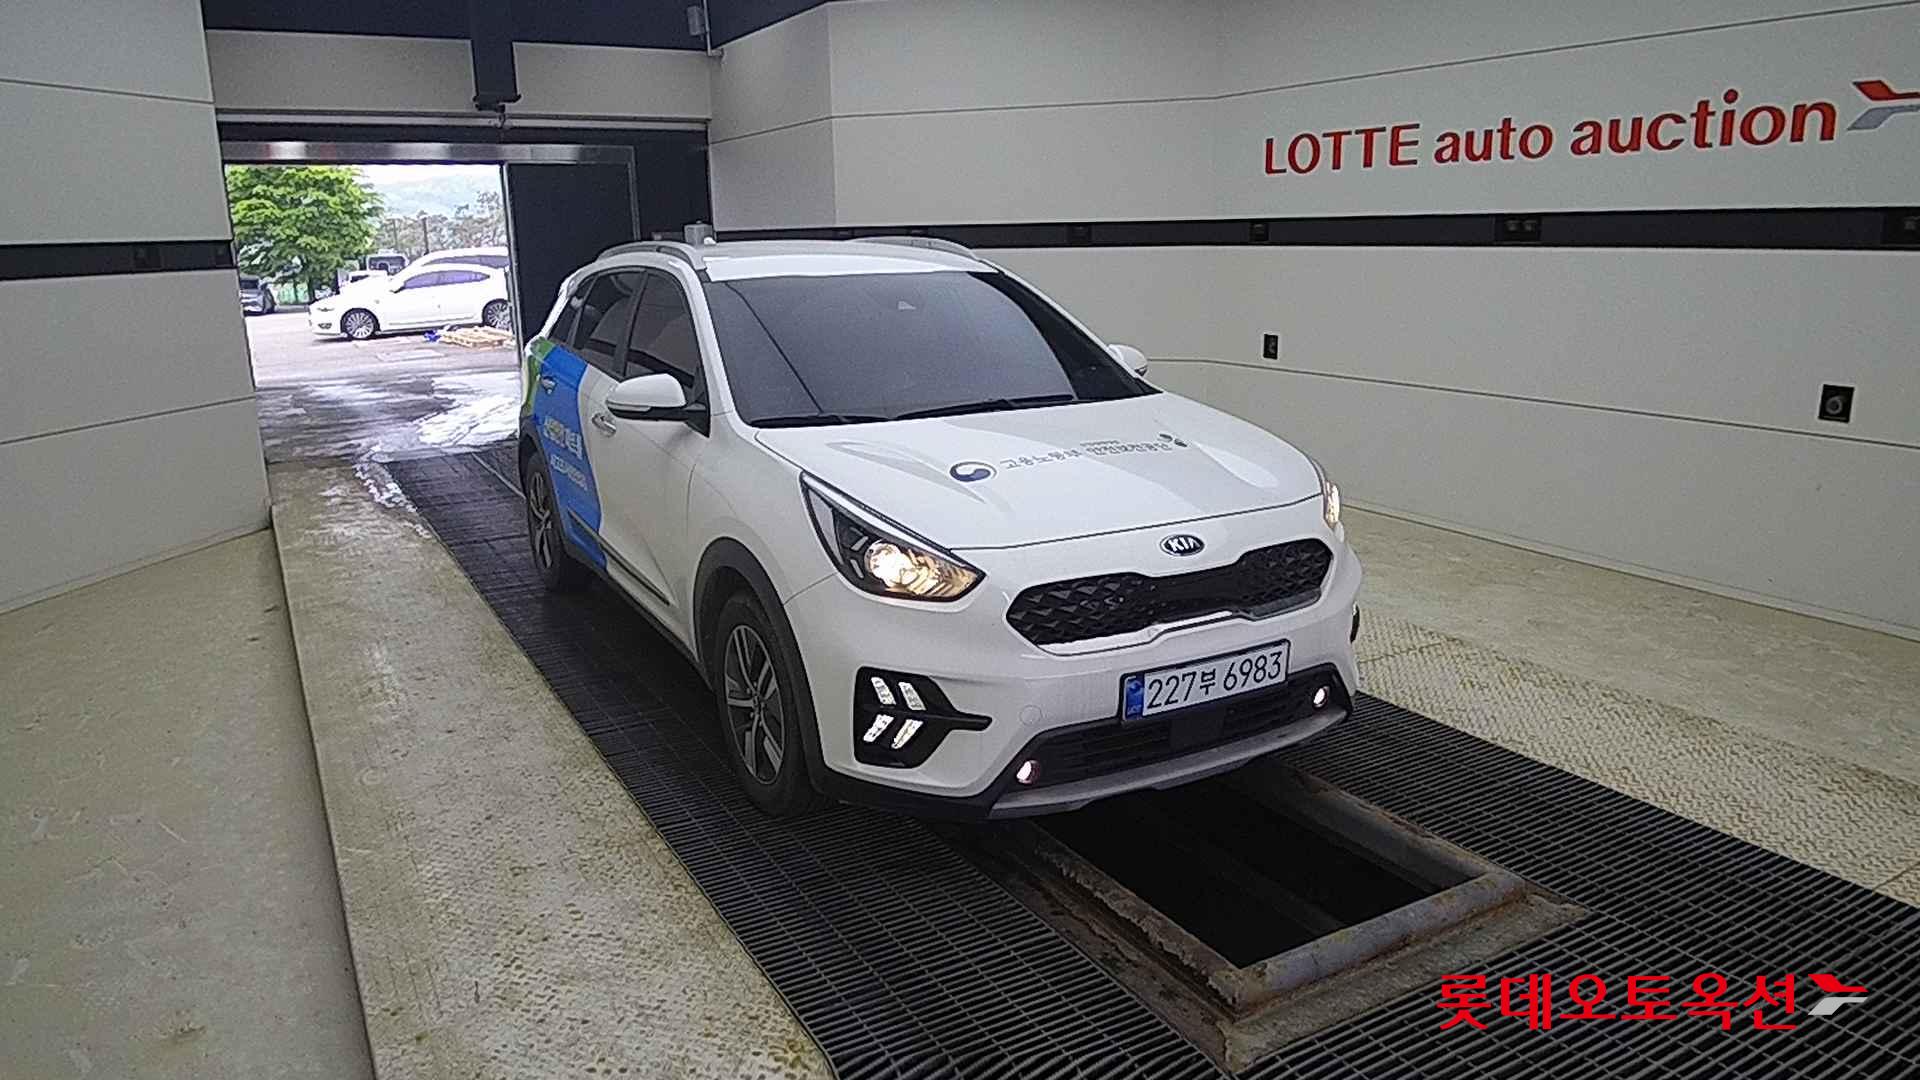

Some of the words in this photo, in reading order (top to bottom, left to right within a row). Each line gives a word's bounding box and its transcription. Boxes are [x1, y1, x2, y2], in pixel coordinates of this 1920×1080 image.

[1265, 122, 1420, 175] LOTTE
[1433, 117, 1554, 164] auto
[1570, 89, 1838, 156] auction
[1167, 536, 1201, 552] KIA
[1146, 668, 1217, 709] 227부
[1223, 651, 1283, 692] 6983
